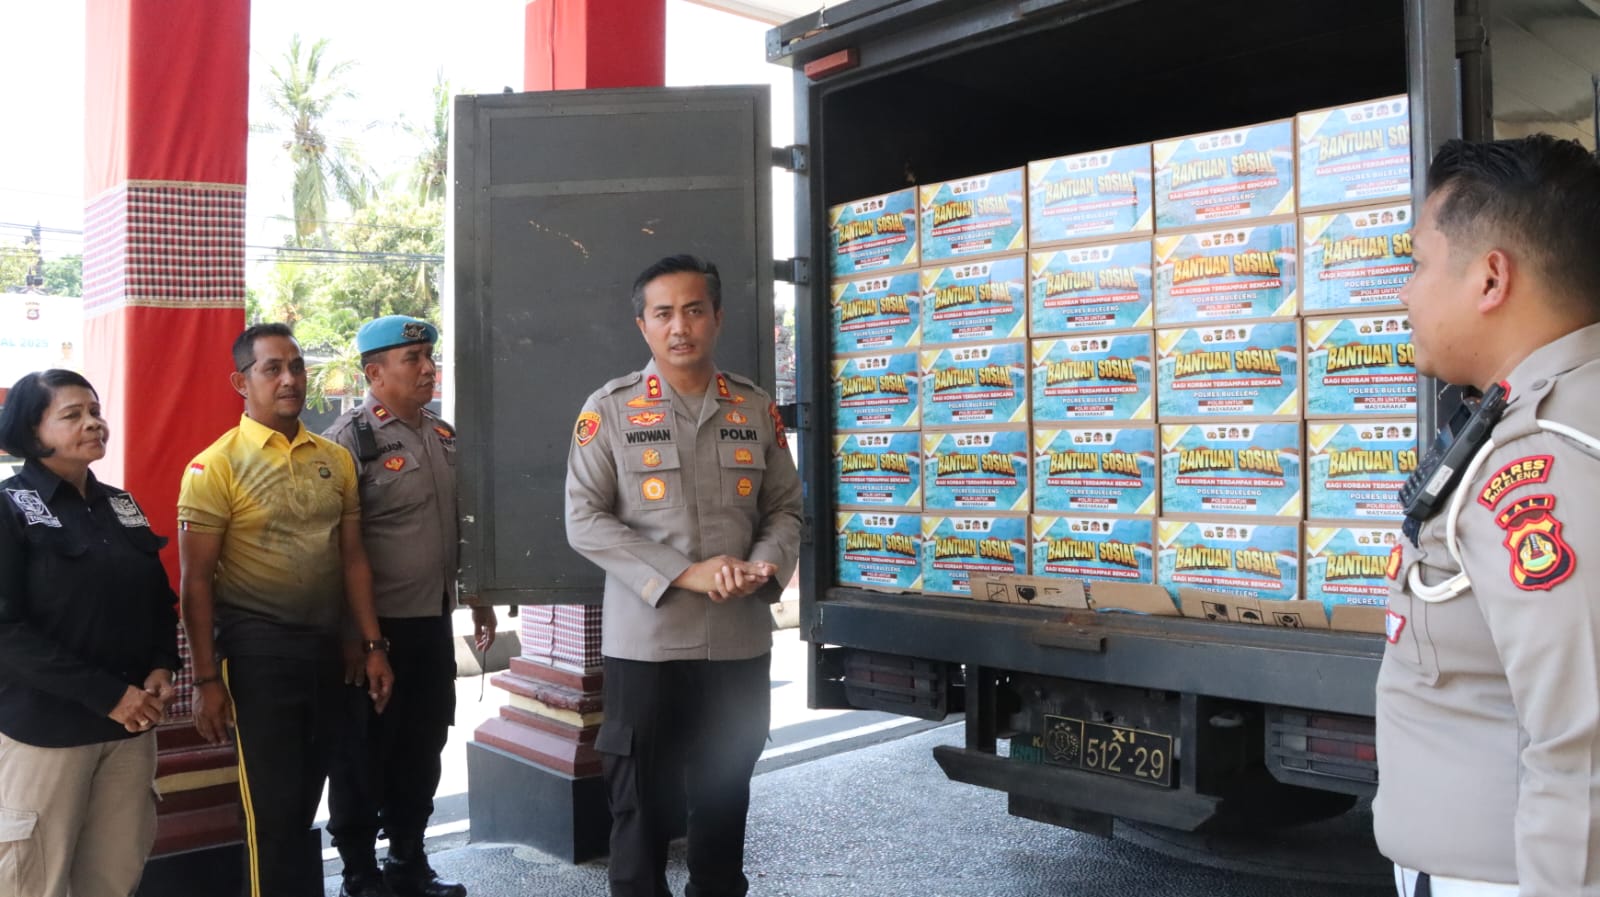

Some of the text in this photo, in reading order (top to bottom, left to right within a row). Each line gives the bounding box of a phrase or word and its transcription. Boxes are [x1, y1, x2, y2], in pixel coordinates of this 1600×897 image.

[1318, 128, 1383, 164] BANTUAN
[1172, 149, 1276, 189] BANTUAN SOSIAL
[934, 194, 1010, 227] BANTUAN SOSIAL
[839, 212, 905, 246] BANTUAN SOSIAL
[1323, 235, 1387, 268] BANTUAN
[1173, 250, 1279, 284] BANTUAN SOSIAL
[1046, 266, 1138, 297] BANTUAN SOSIAL
[841, 294, 909, 323] BANTUAN SOSIAL
[935, 281, 1012, 311] BANTUAN SOSIAL
[1047, 358, 1136, 385] BANTUAN SOSIAL
[1174, 348, 1281, 378] BANTUAN SOSIAL
[1326, 343, 1392, 373] BANTUAN
[841, 374, 908, 398] BANTUAN SOSIAL
[934, 365, 1013, 392] BANTUAN SOSIAL
[1381, 385, 1416, 393] BULELEN
[626, 429, 671, 444] WIDWAN
[720, 428, 758, 440] POLRI
[842, 453, 909, 474] BANTUAN SOSIAL
[937, 453, 1015, 476] BANTUAN SOSIAL
[1049, 452, 1140, 477] BANTUAN SOSIAL
[1178, 449, 1283, 476] BANTUAN SOSIAL
[1328, 450, 1392, 477] BANTUAN
[1482, 460, 1545, 500] POLRES
[1490, 470, 1540, 502] BULELENG
[1500, 498, 1548, 523] BALI
[846, 532, 915, 557] BANTUAN SOSIAL
[935, 538, 1014, 563] BANTUAN SOSIAL
[1047, 539, 1138, 568] BANTUAN SOSIAL
[1175, 546, 1280, 578] BANTUAN SOSIAL
[1325, 554, 1389, 580] BANTUAN
